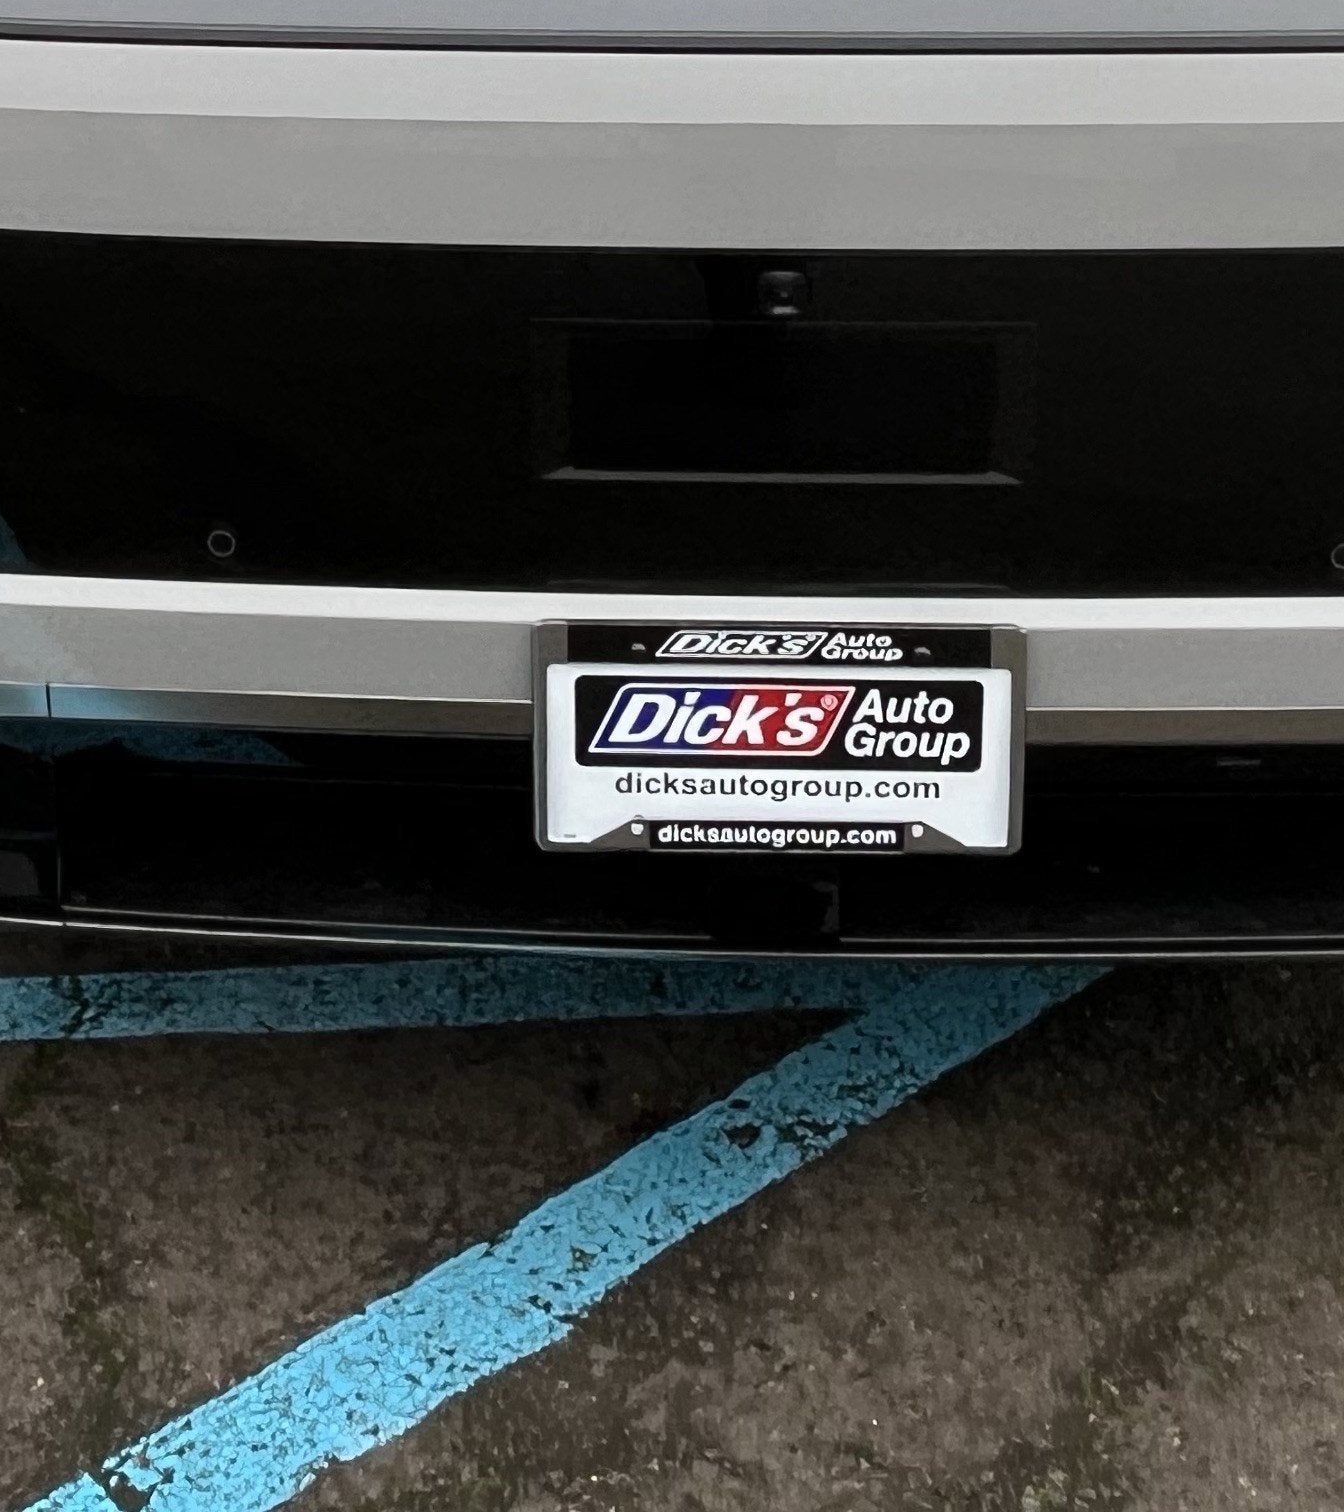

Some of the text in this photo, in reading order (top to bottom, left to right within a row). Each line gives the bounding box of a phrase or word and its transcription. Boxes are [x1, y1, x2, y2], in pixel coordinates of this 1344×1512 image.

[821, 646, 903, 661] Group
[828, 632, 892, 648] Auto
[852, 689, 954, 724] Auto
[844, 722, 971, 766] Group
[615, 772, 941, 802] dicksautogroup.com
[657, 823, 897, 848] dicksautogroup.com
